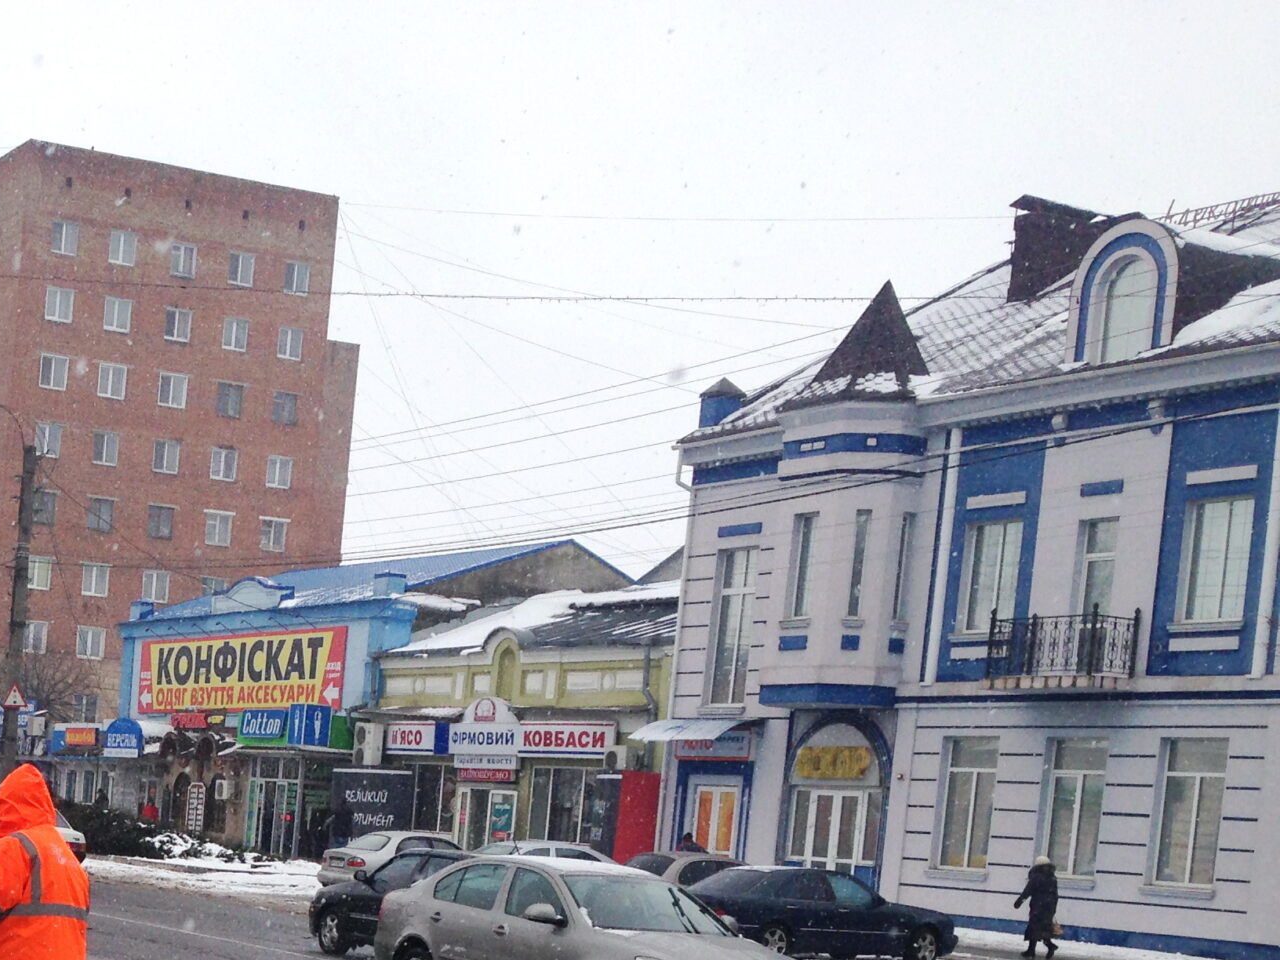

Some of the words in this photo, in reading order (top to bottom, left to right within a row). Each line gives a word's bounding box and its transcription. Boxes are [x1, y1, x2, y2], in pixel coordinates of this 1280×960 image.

[156, 637, 324, 686] КОНФІСКАТ
[156, 687, 187, 708] ОДЯГ
[191, 685, 234, 706] ВЗУТТЯ
[237, 684, 316, 705] АКСЕСУАРИ
[242, 711, 282, 735] Cotton
[451, 729, 515, 746] ФІРМОВИЙ
[523, 730, 606, 749] КОВБАСИ
